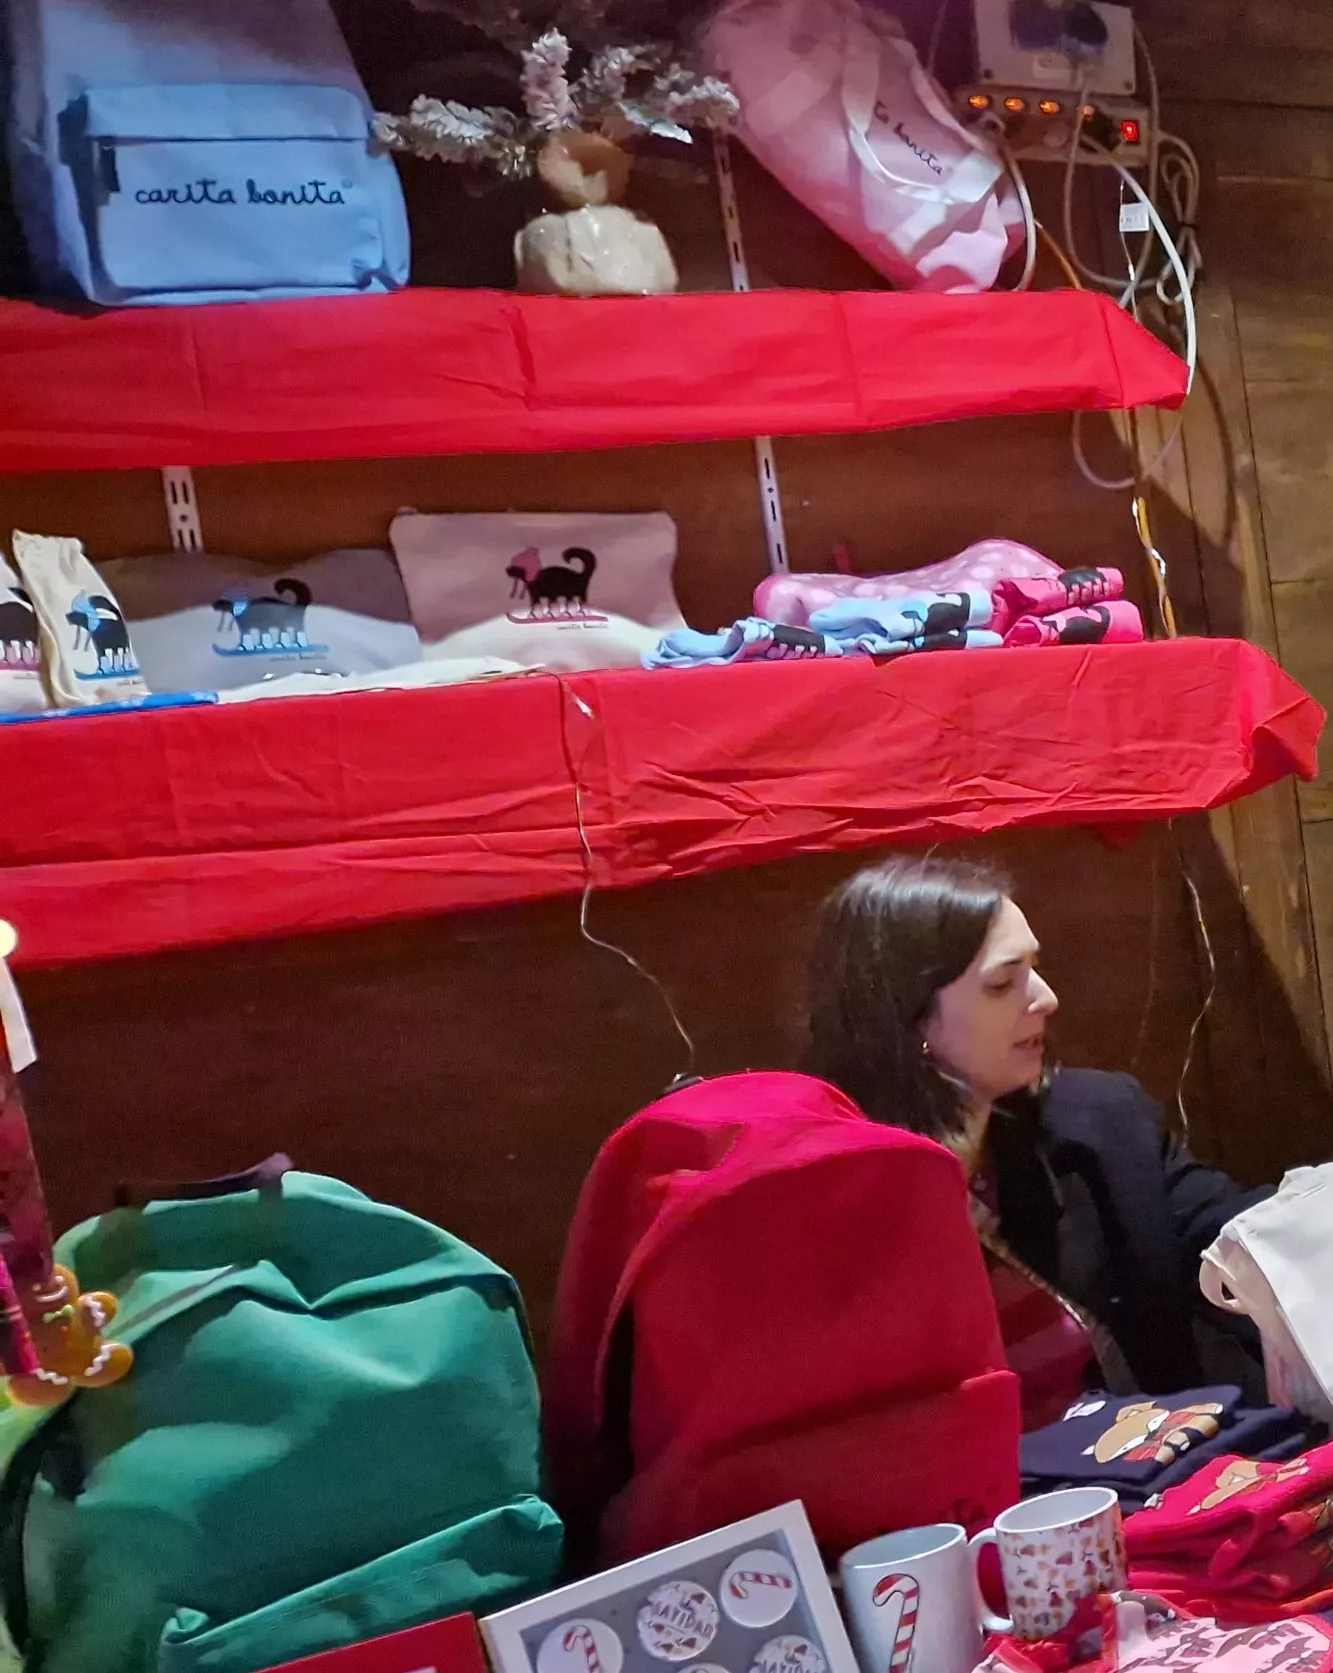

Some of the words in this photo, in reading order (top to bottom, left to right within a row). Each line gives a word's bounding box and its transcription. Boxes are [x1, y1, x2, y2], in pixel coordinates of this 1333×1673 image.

[892, 121, 943, 176] bonita
[135, 178, 237, 205] carita
[245, 178, 346, 205] bonita
